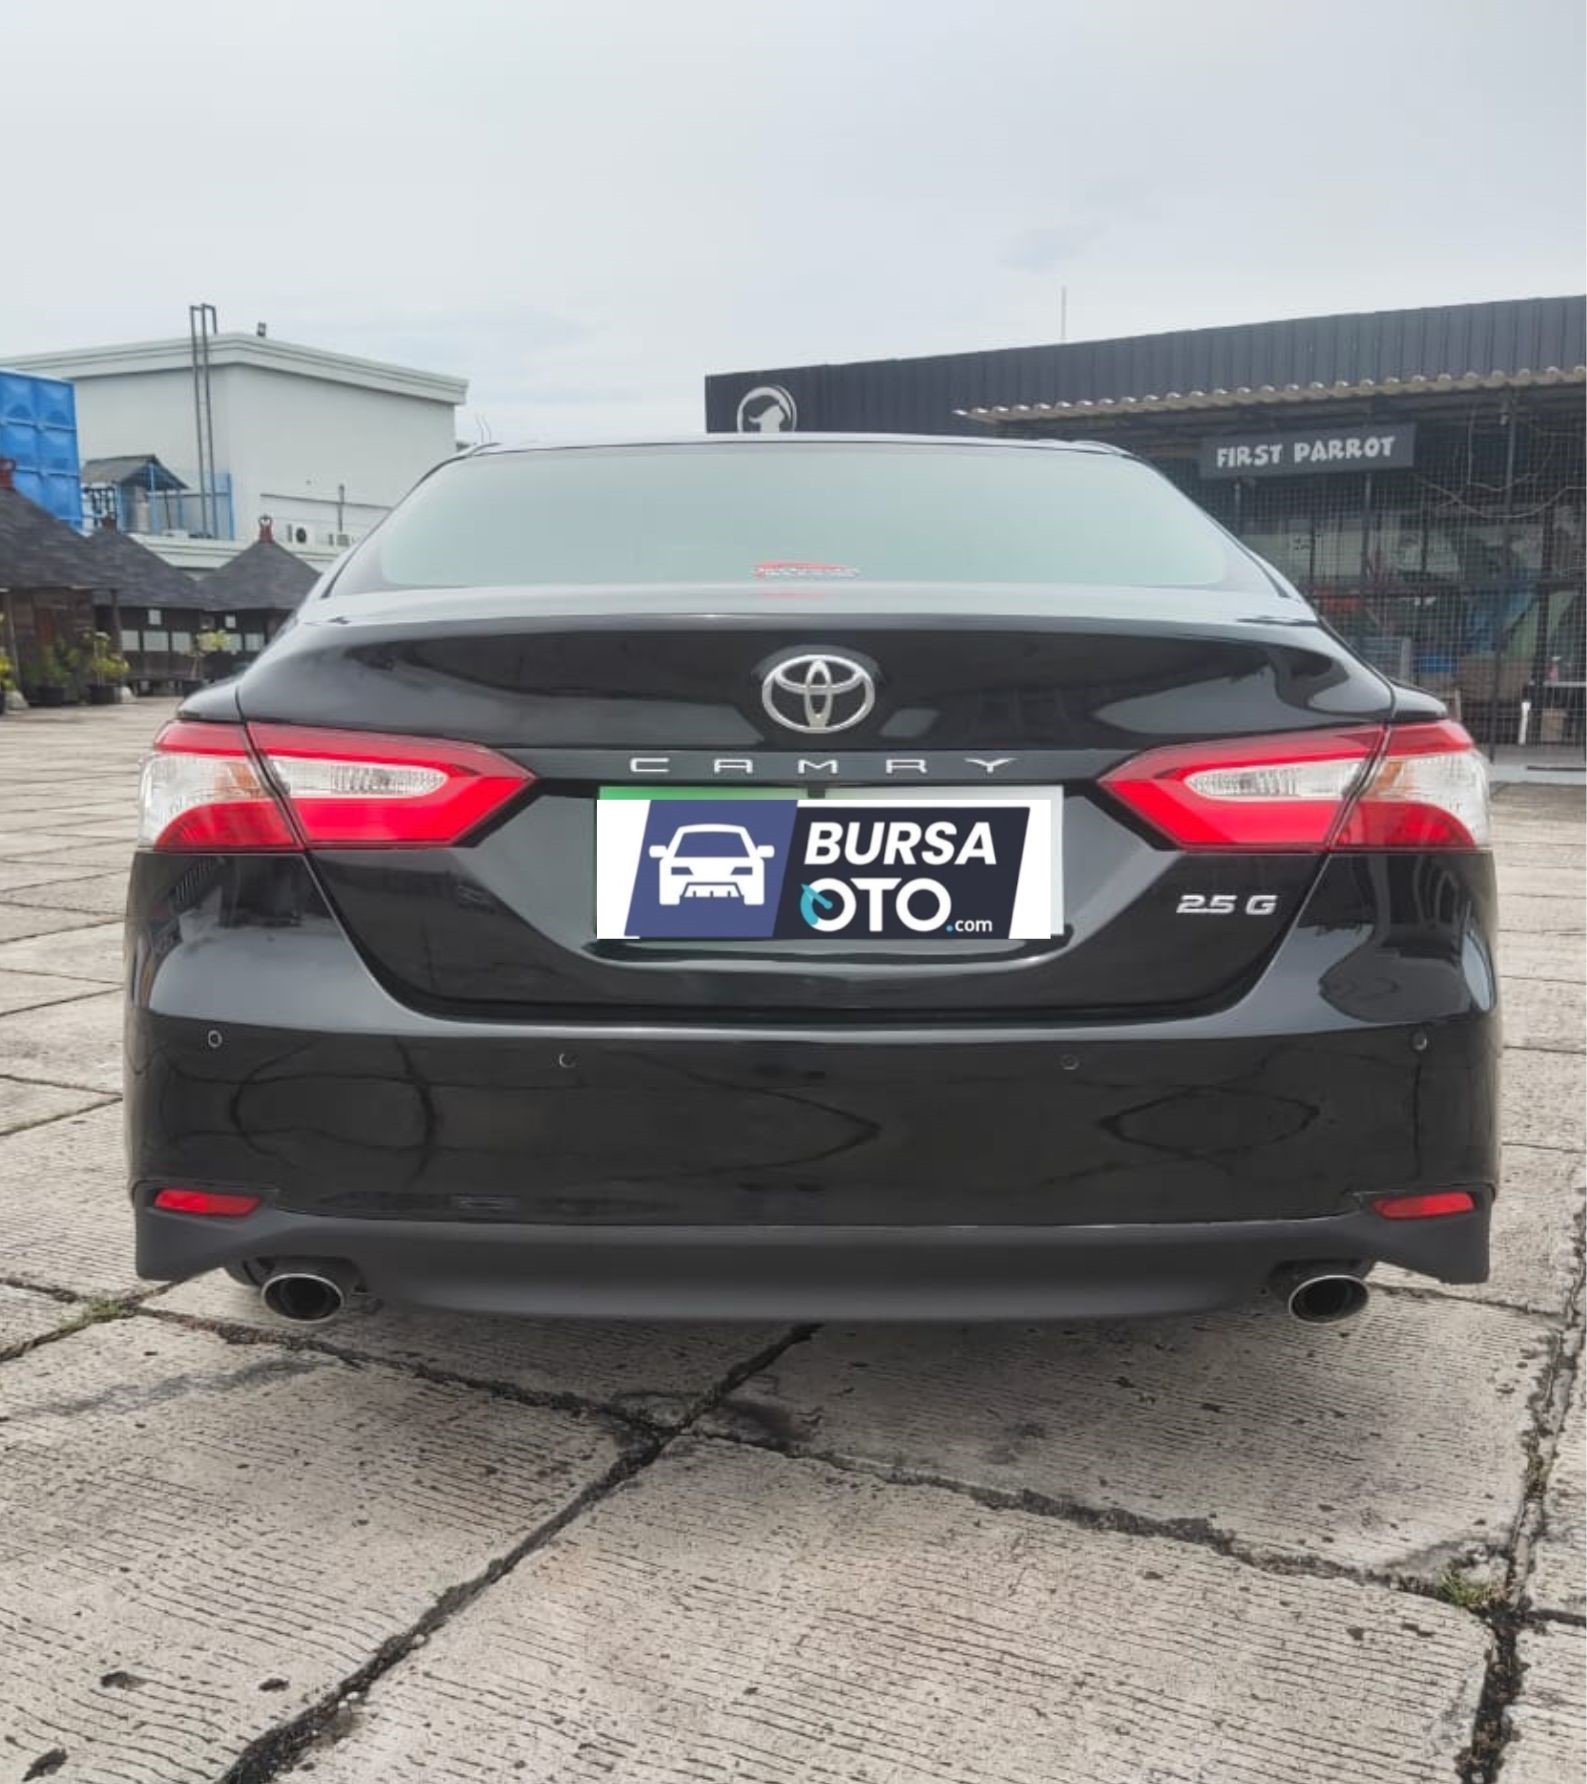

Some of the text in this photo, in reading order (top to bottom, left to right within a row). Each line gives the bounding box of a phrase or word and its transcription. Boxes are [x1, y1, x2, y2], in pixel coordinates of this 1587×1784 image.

[1216, 436, 1395, 468] FIRST PARROT
[630, 757, 1017, 774] CAMRY
[1245, 895, 1278, 915] G
